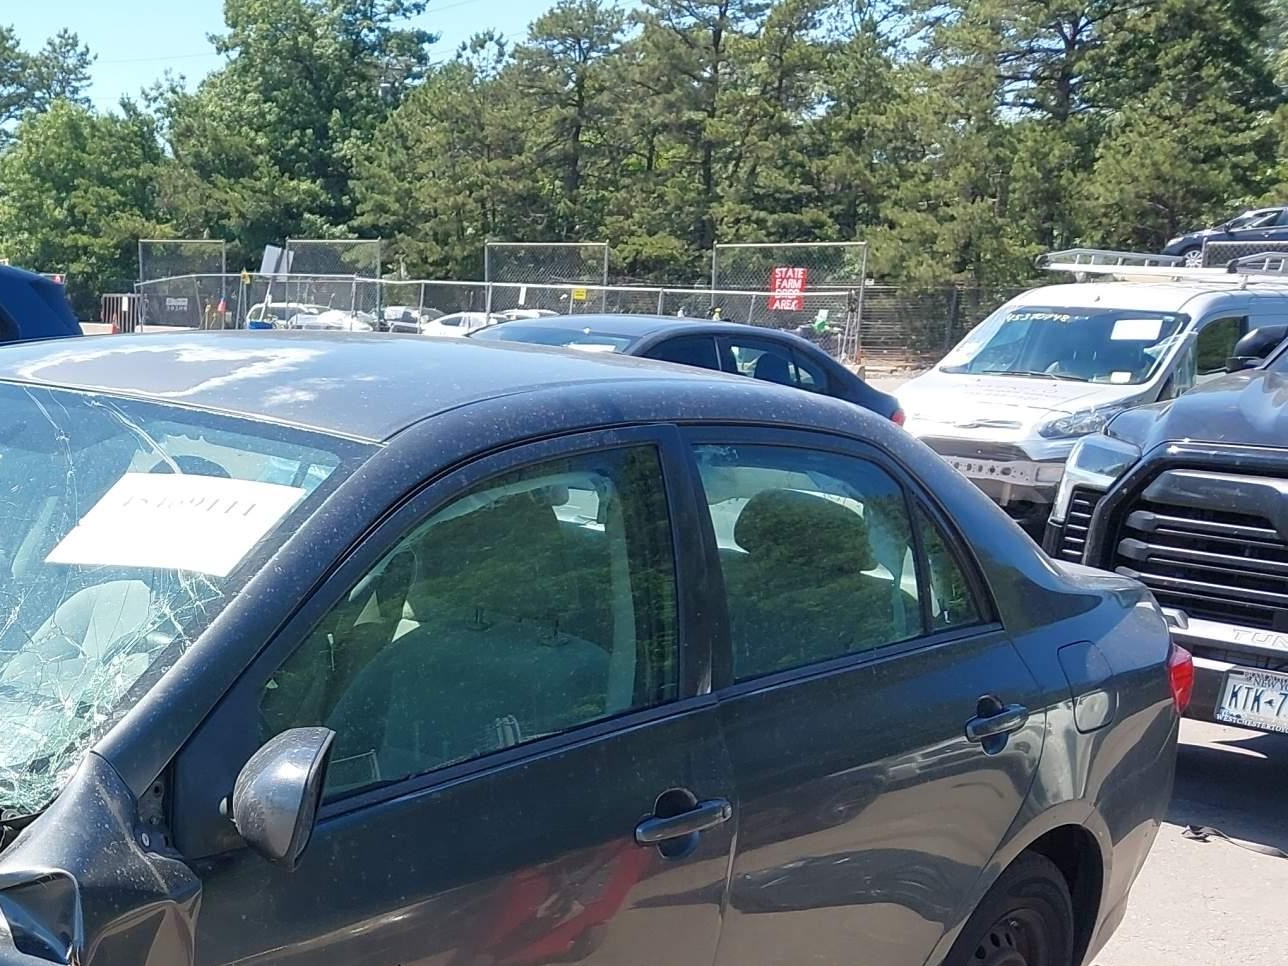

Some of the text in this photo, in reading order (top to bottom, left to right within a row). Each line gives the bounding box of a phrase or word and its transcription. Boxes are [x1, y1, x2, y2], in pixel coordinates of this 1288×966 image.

[775, 267, 804, 279] STATE
[775, 279, 802, 289] FARM
[772, 299, 799, 311] AREA
[1253, 678, 1280, 689] NEW
[1228, 684, 1266, 713] KTK
